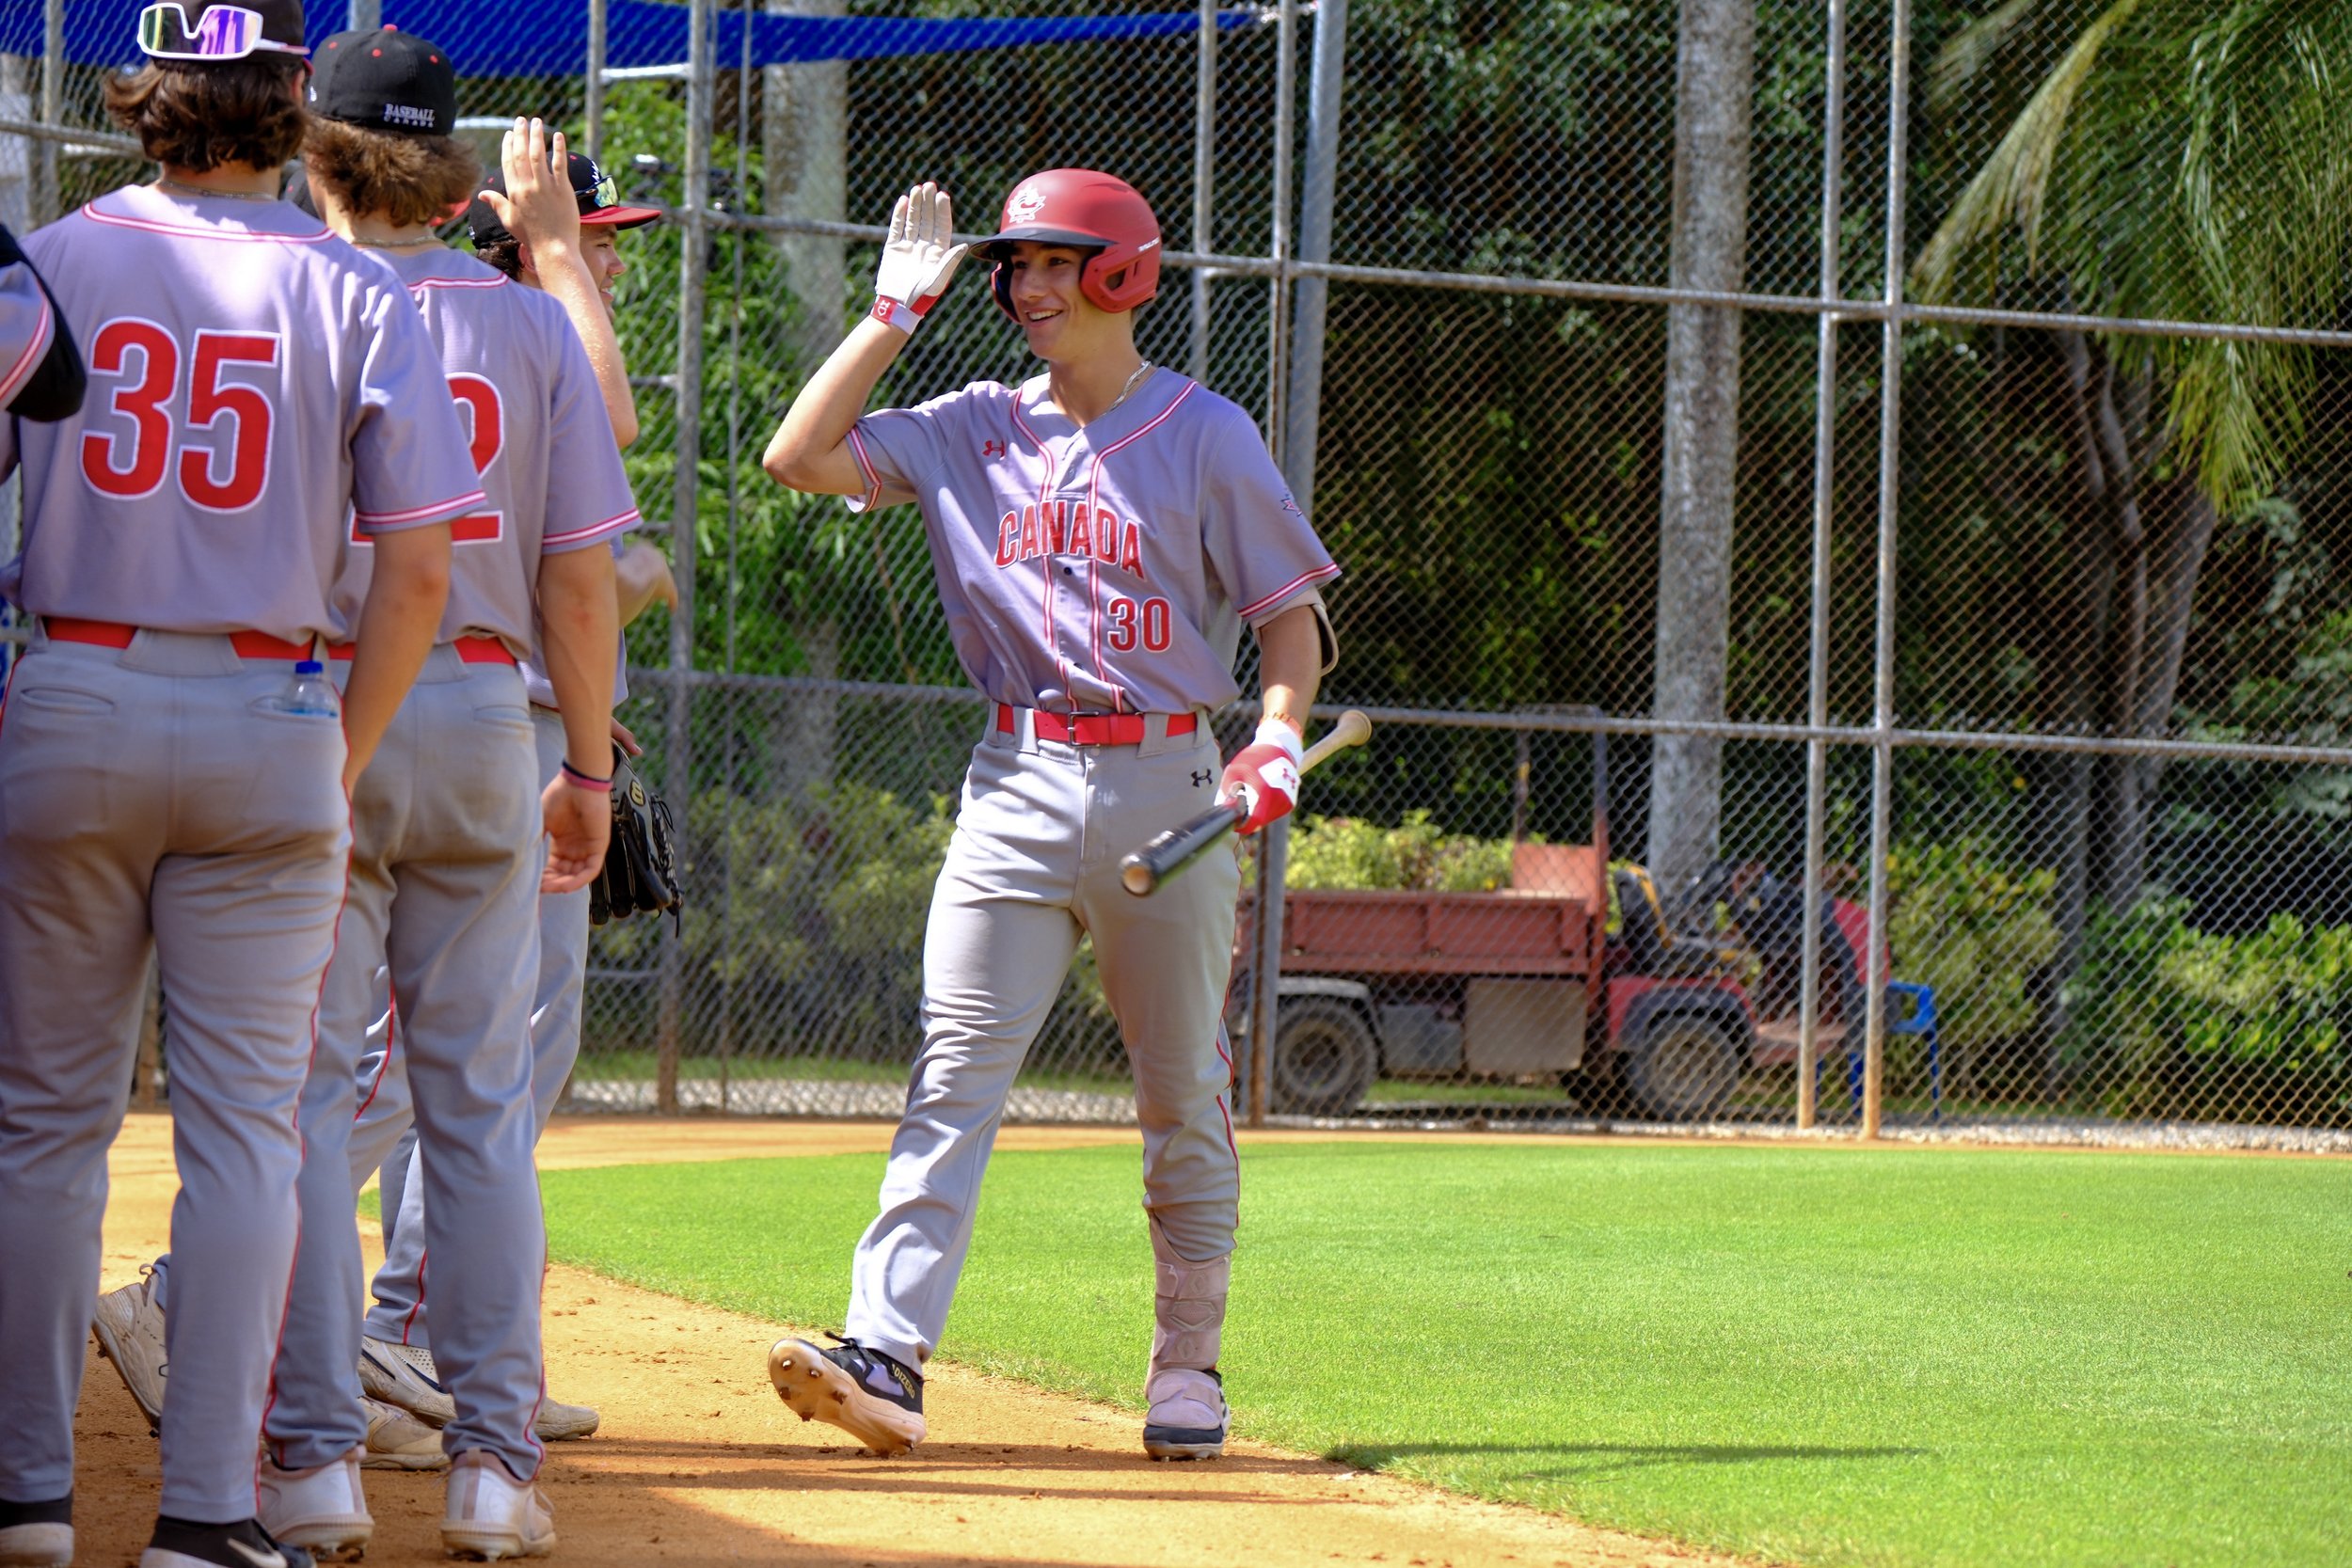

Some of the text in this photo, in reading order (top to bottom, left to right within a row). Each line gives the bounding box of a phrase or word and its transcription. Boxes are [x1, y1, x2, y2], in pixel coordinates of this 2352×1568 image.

[385, 103, 435, 121] BASEBALL
[82, 316, 280, 514] 35
[994, 499, 1146, 581] CANADA
[1107, 596, 1172, 653] 30
